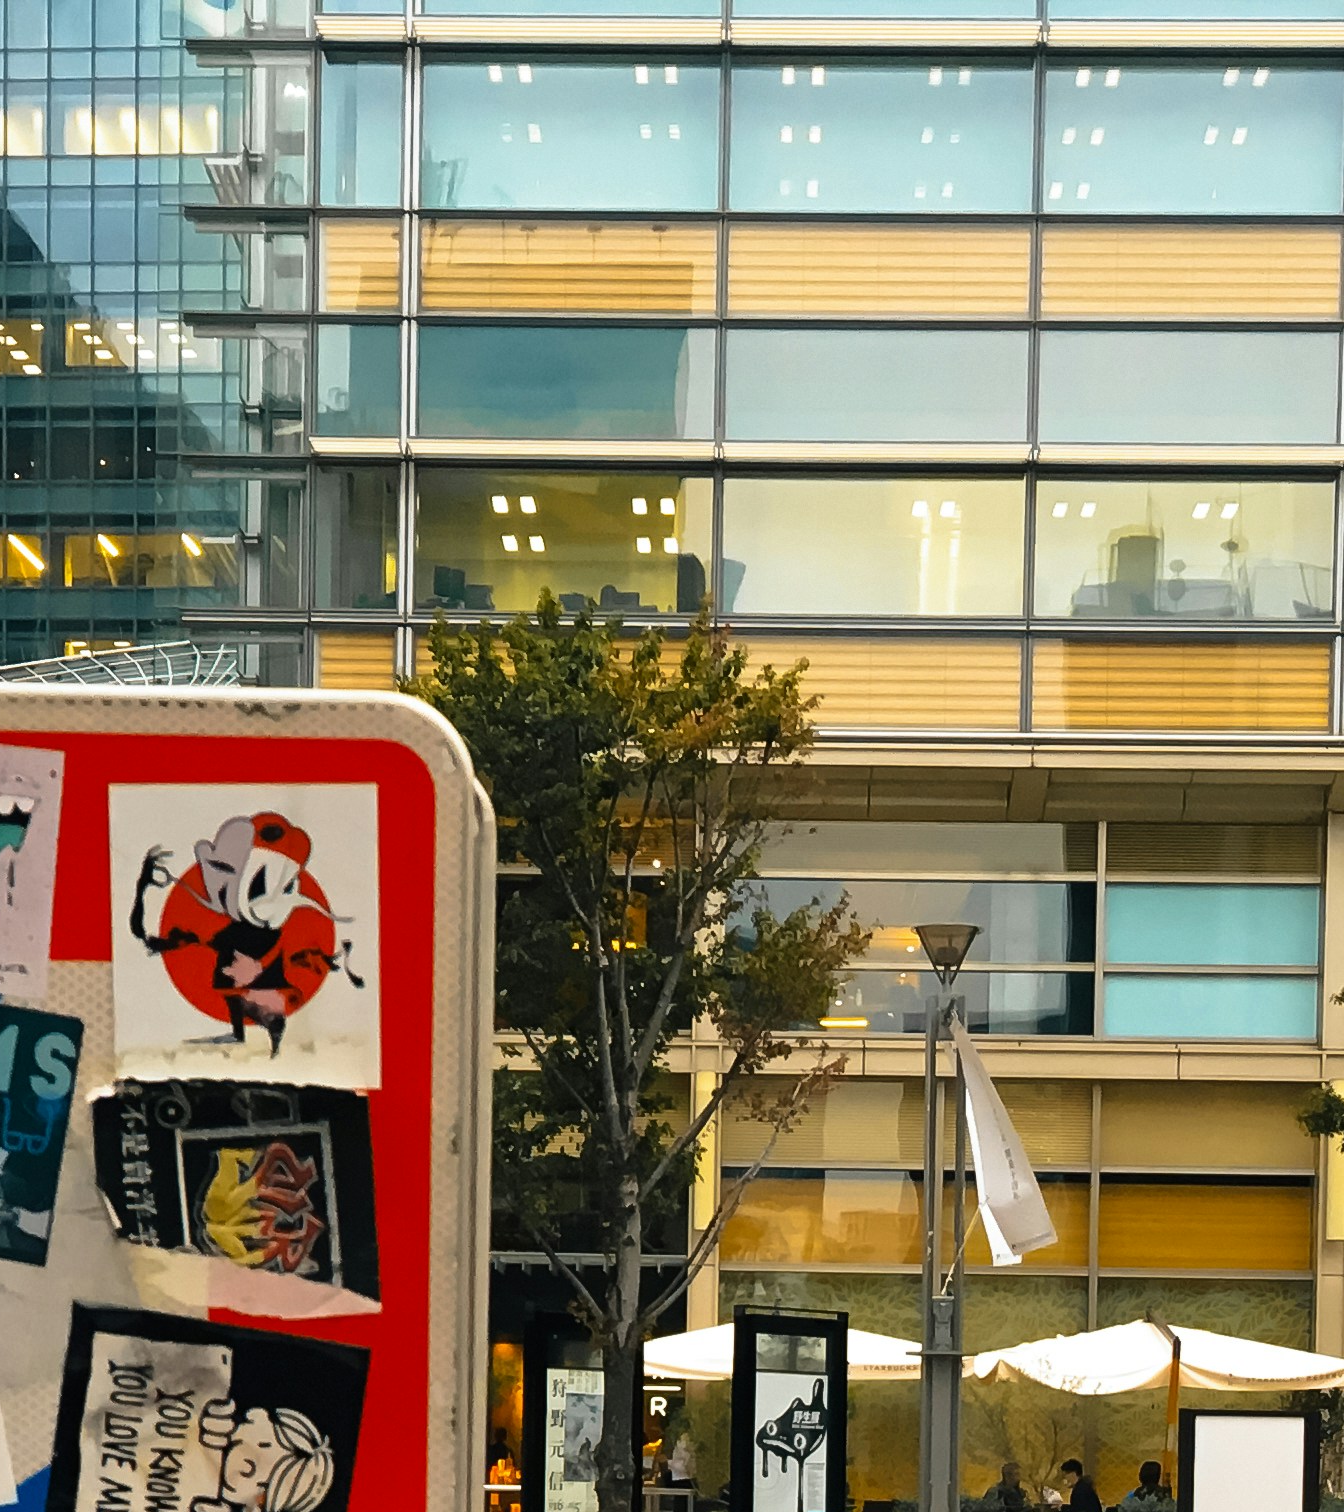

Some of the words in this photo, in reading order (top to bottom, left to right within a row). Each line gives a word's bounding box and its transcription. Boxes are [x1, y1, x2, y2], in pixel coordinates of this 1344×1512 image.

[108, 1359, 154, 1408] YOU
[650, 1396, 668, 1417] R
[155, 1388, 195, 1439] YOU
[101, 1411, 144, 1474] LOVE
